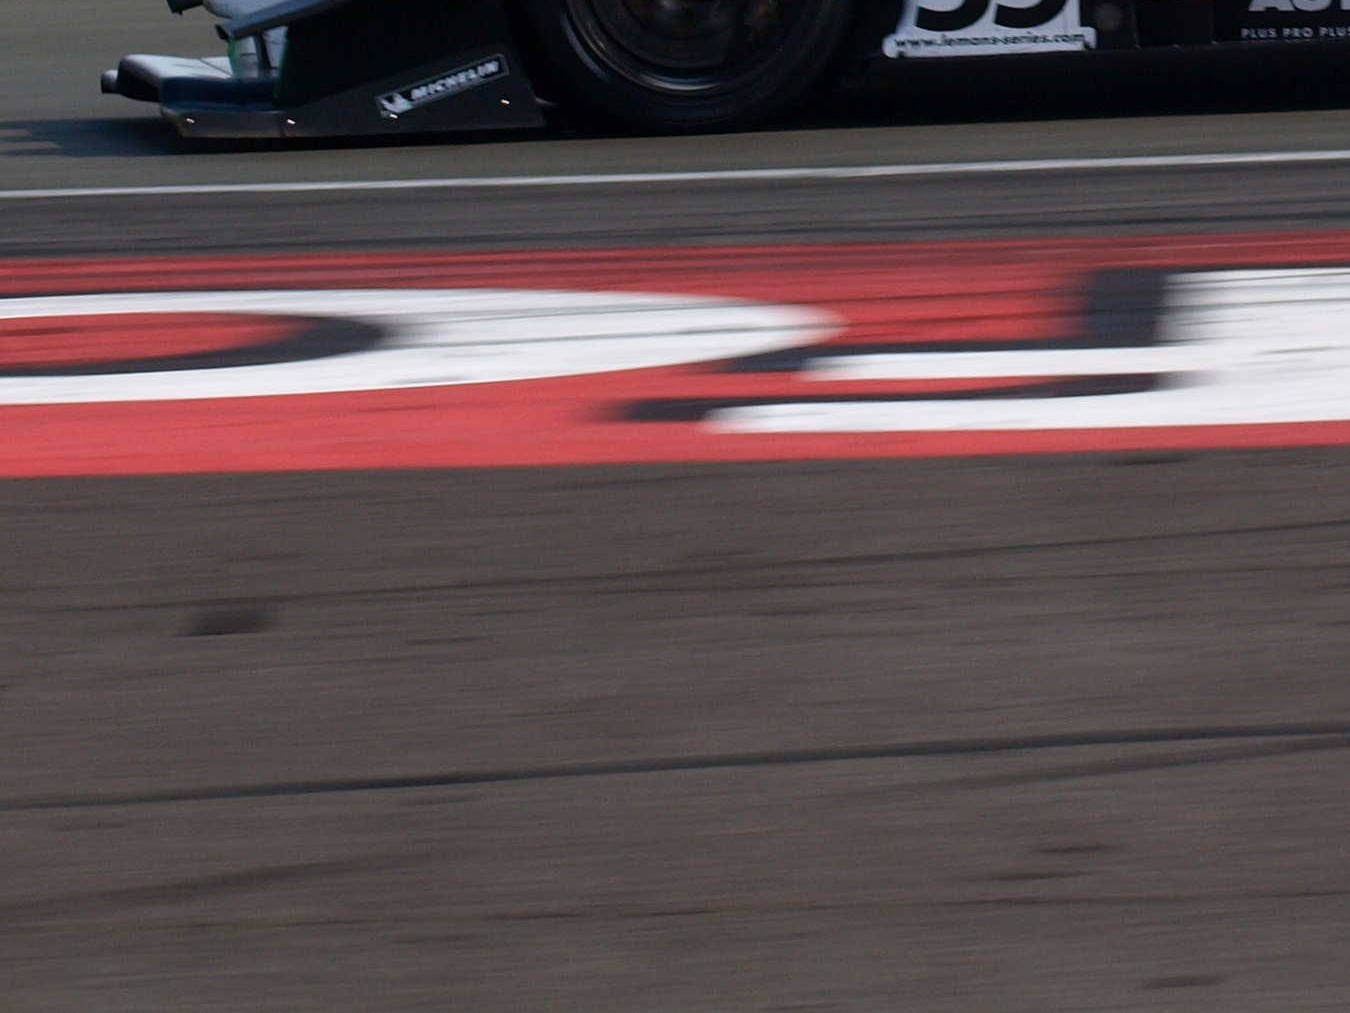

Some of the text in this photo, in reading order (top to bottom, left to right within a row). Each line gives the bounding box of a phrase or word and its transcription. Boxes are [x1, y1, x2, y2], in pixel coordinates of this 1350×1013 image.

[894, 30, 1086, 47] www.lemans-series.com
[1240, 27, 1277, 38] PLUS
[1282, 27, 1314, 38] PRO
[410, 60, 500, 99] MICHELIN
